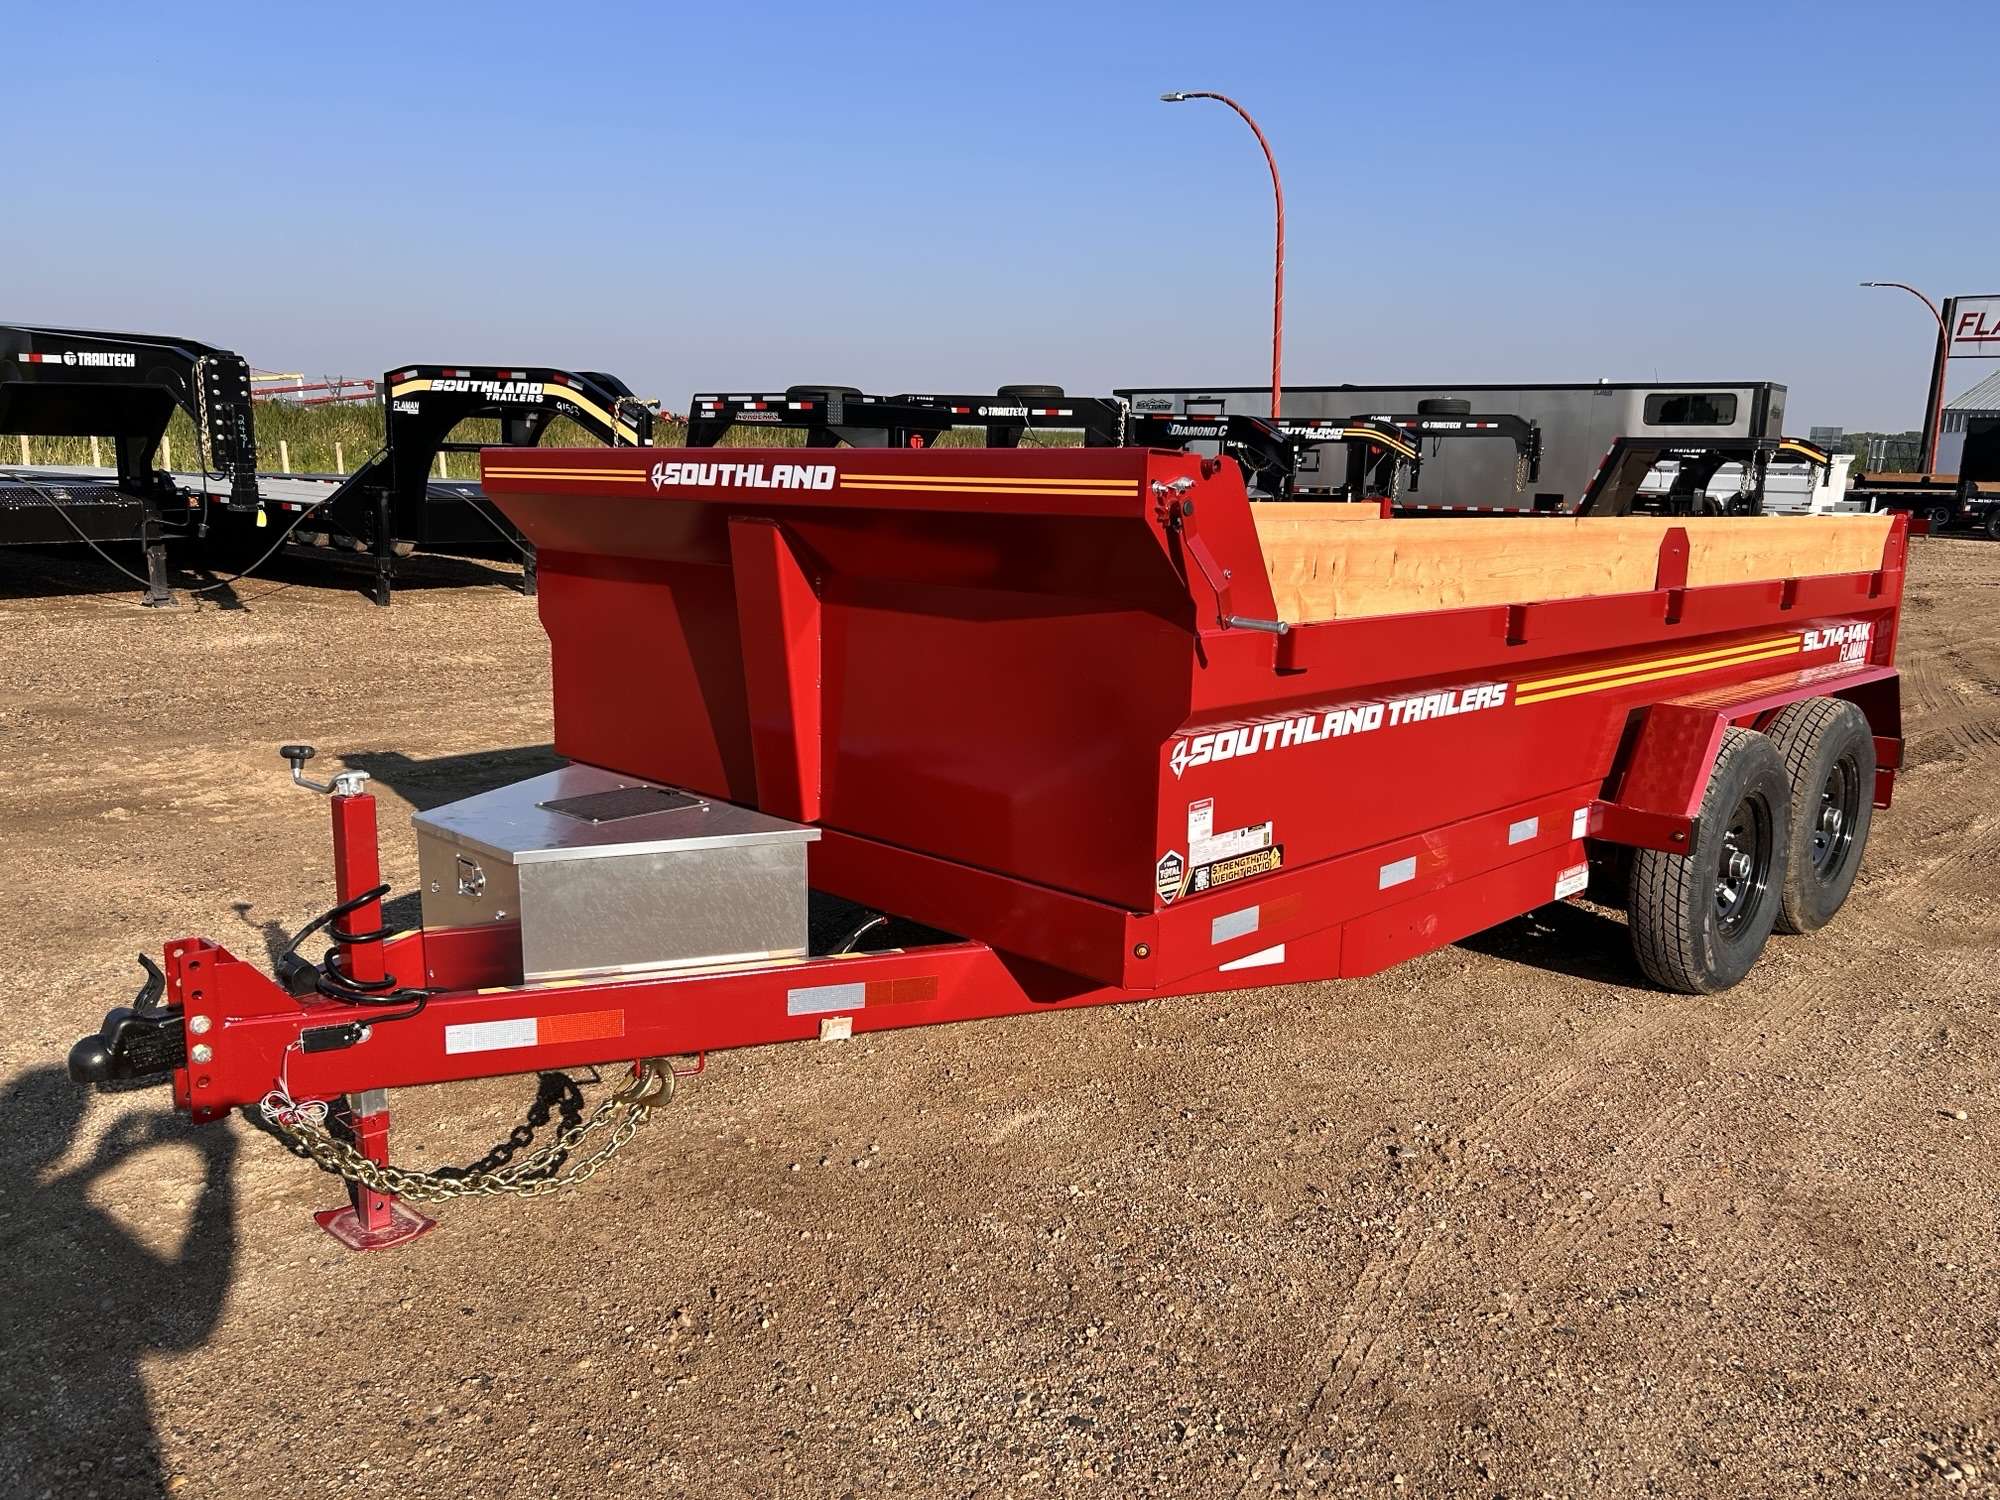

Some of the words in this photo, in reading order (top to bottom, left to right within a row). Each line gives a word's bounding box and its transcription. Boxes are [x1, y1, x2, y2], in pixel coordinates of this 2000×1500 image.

[77, 352, 135, 367] TRAILTECH
[430, 379, 543, 395] SOUTHLAND
[393, 400, 420, 410] FLAMAN
[485, 392, 544, 403] TRAILERS
[988, 406, 1028, 417] TRAILTECH
[1171, 424, 1217, 437] DIAMOND
[1218, 425, 1228, 437] C
[1277, 427, 1344, 435] OUTHLAND
[1430, 421, 1462, 429] TRAILTECH
[664, 463, 837, 490] SOUTHLAND
[1802, 622, 1872, 652] SL714-14K
[1839, 641, 1867, 662] FLAMAN
[1188, 704, 1385, 768] SOUTHLAND
[1388, 683, 1508, 727] TRAILERS
[1212, 855, 1257, 875] STRENGTH
[1258, 851, 1270, 862] TO
[1211, 868, 1245, 884] WEIGHT
[1246, 862, 1271, 875] RATIO
